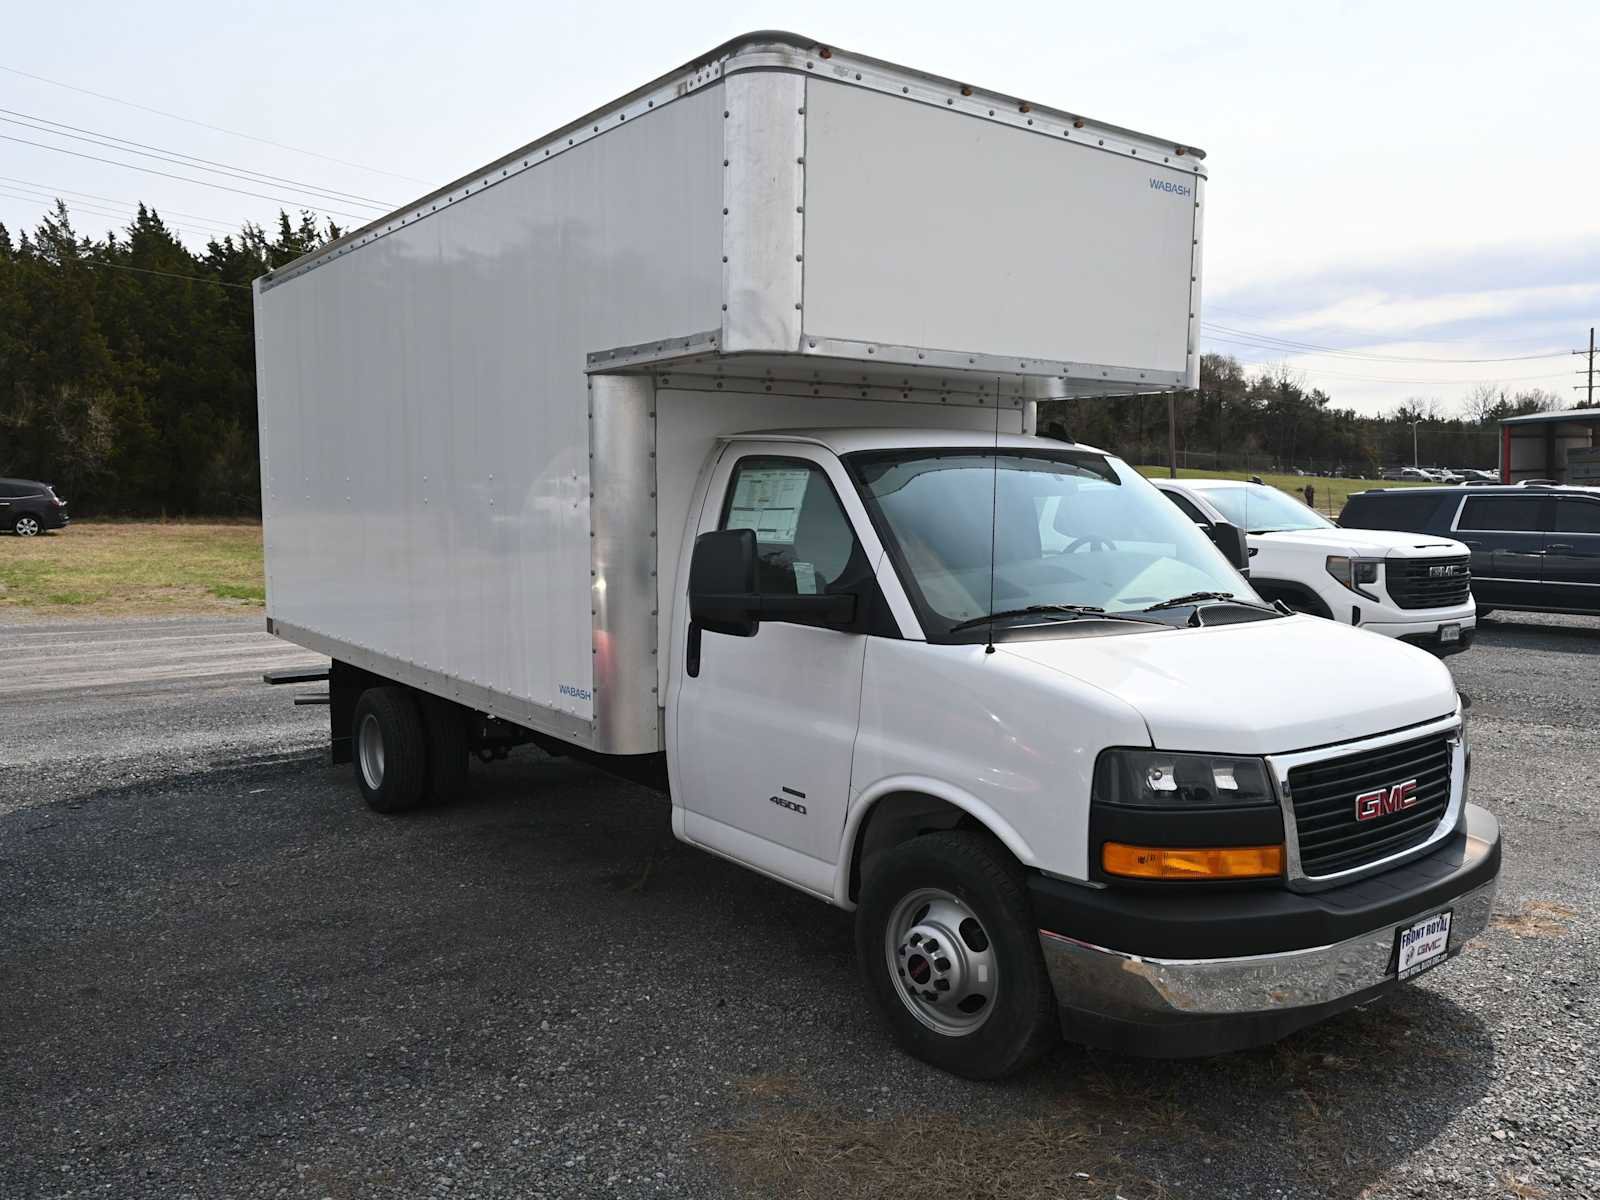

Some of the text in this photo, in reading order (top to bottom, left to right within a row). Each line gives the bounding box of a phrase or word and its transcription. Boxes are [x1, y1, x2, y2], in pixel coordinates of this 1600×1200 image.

[1149, 177, 1191, 197] WABASH
[558, 683, 592, 701] WABASH
[1355, 779, 1417, 822] GMC
[1402, 926, 1426, 950] FRONT
[1426, 917, 1448, 937] ROYAL
[1417, 938, 1442, 956] GMC
